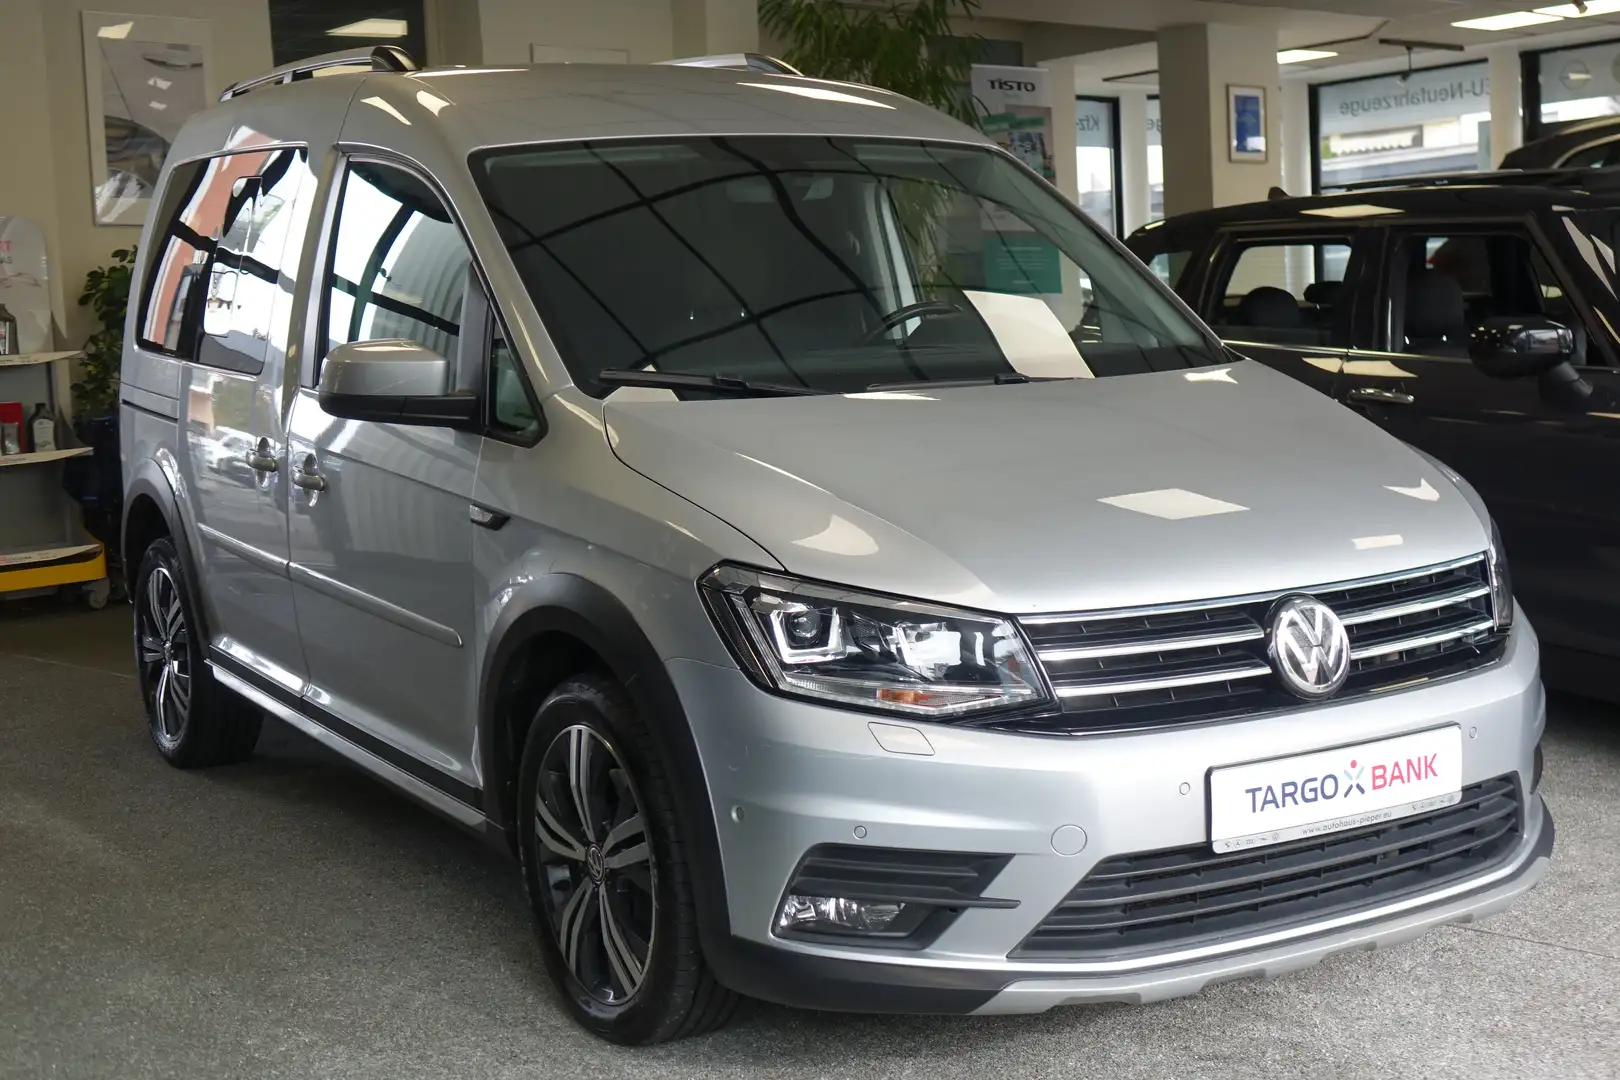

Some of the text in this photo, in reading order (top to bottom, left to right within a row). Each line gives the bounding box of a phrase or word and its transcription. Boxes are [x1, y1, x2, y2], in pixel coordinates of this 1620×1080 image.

[1245, 753, 1438, 813] TARGO BANK
[1301, 811, 1392, 835] www.autohaus-pieper.eu
